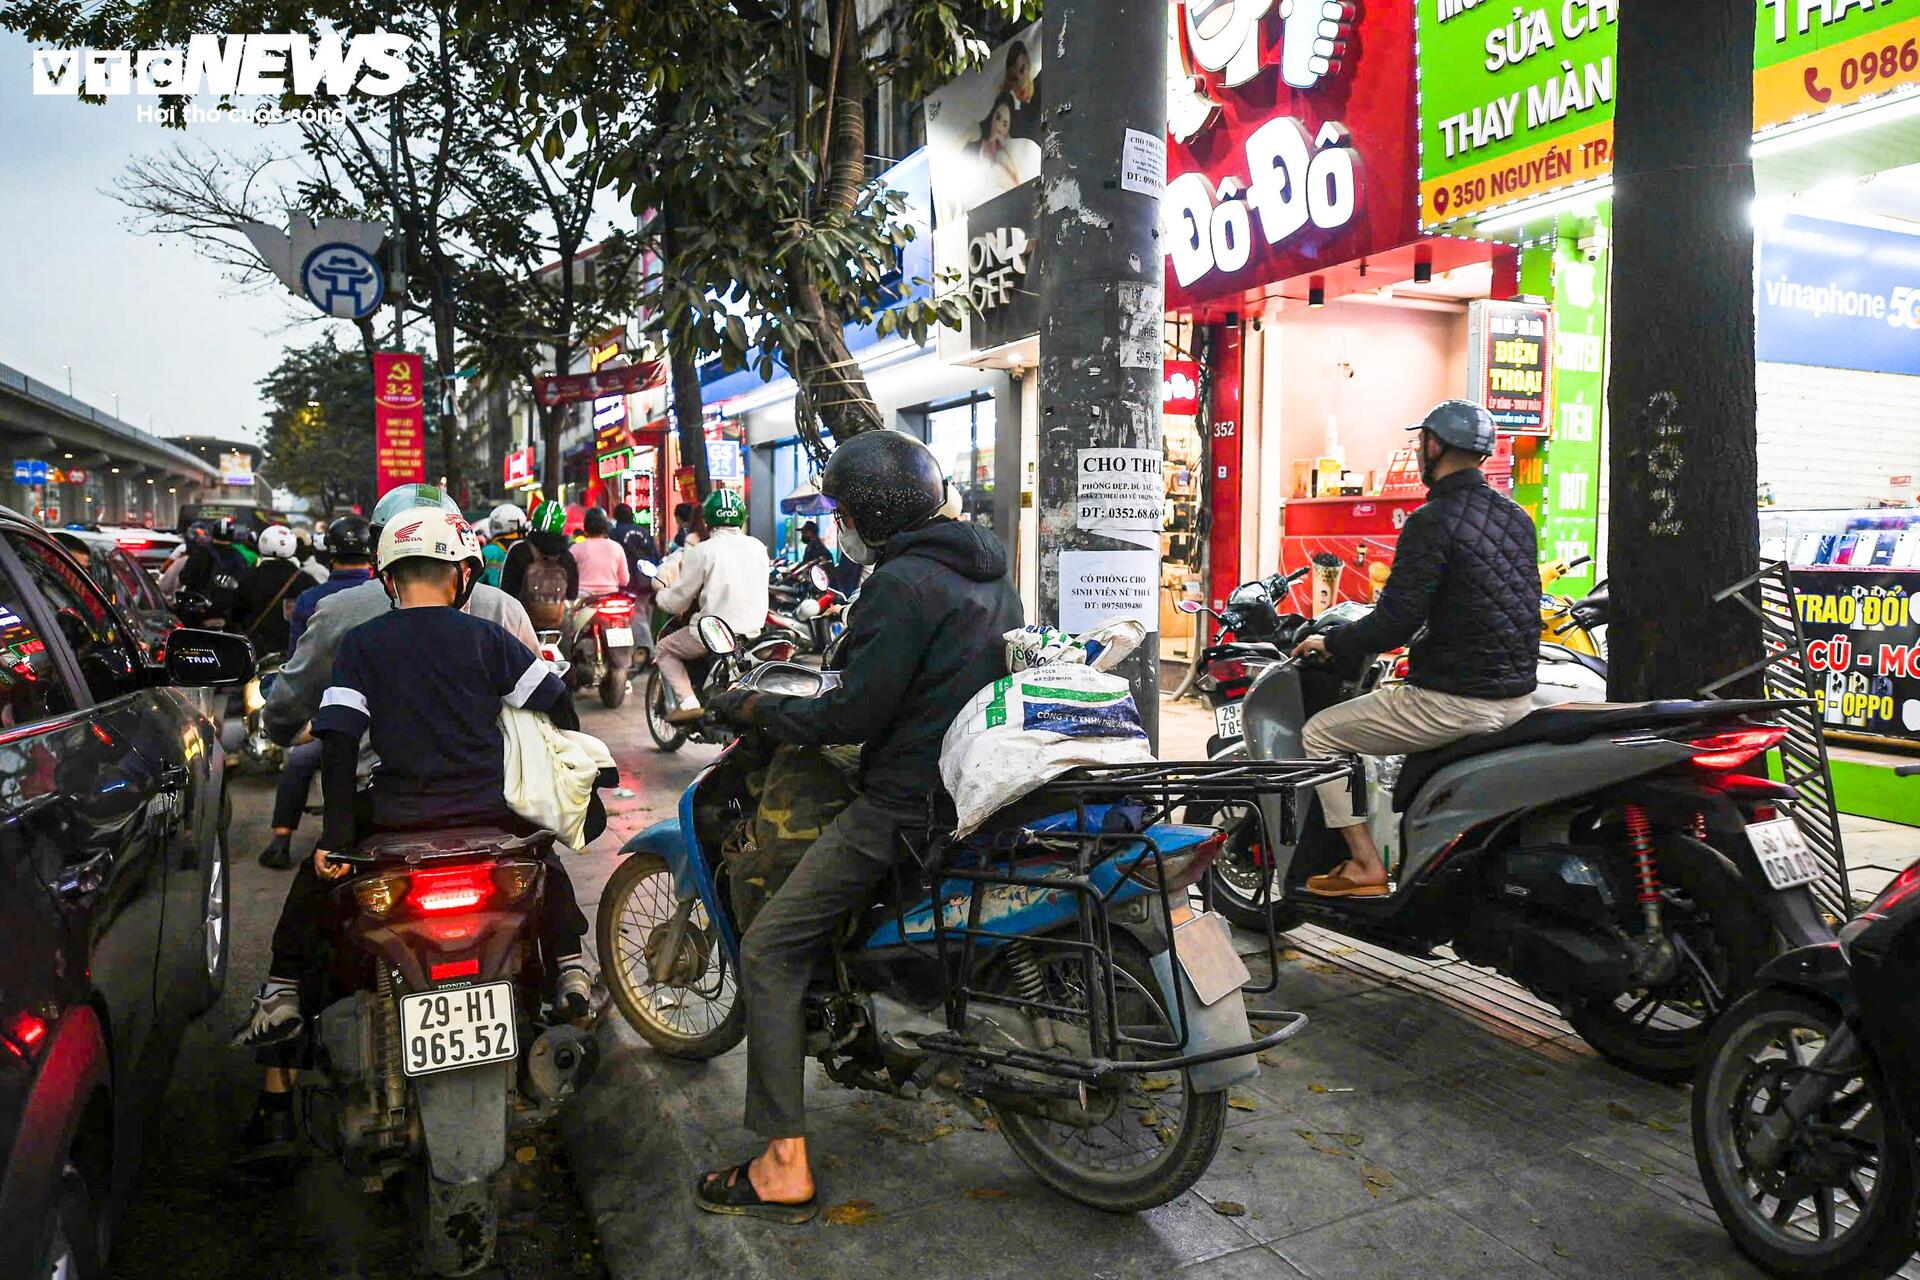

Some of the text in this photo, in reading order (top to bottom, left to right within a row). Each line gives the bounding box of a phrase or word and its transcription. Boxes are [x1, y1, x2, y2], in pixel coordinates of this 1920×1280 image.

[1765, 0, 1893, 41] THA
[1485, 8, 1555, 72] SỬA
[1840, 37, 1919, 90] 0986
[1438, 56, 1612, 159] THAY MÀN
[1453, 177, 1485, 208] 350
[969, 266, 1015, 311] OFF
[1765, 274, 1886, 319] vinaphone
[1495, 337, 1539, 368] ĐIỆN
[1490, 368, 1543, 396] THOẠI
[1214, 420, 1235, 438] 352
[709, 444, 733, 459] GS
[1083, 456, 1127, 473] CHO
[710, 459, 732, 474] 25
[1519, 457, 1542, 485] PIN
[1082, 480, 1111, 491] PHÒNG
[1559, 464, 1589, 511] RÚT
[716, 508, 739, 519] Grab
[1081, 506, 1165, 520] ĐT: 0352.68.69
[394, 536, 423, 545] HONDA
[1071, 588, 1093, 597] SINH
[1094, 586, 1117, 597] VIÊN
[1118, 587, 1132, 597] NỮ
[1080, 573, 1147, 584] CÓ PHÒNG CHO
[1795, 585, 1909, 627] TRAO ĐỔI
[1806, 634, 1852, 672] CŨ
[1036, 709, 1062, 721] CÔNG
[1065, 713, 1076, 722] TY
[1078, 715, 1101, 726] TNHH
[1841, 693, 1893, 721] OPPO
[437, 981, 472, 990] HONDA
[418, 988, 496, 1031] 29-H1
[411, 1022, 511, 1069] 965.52
